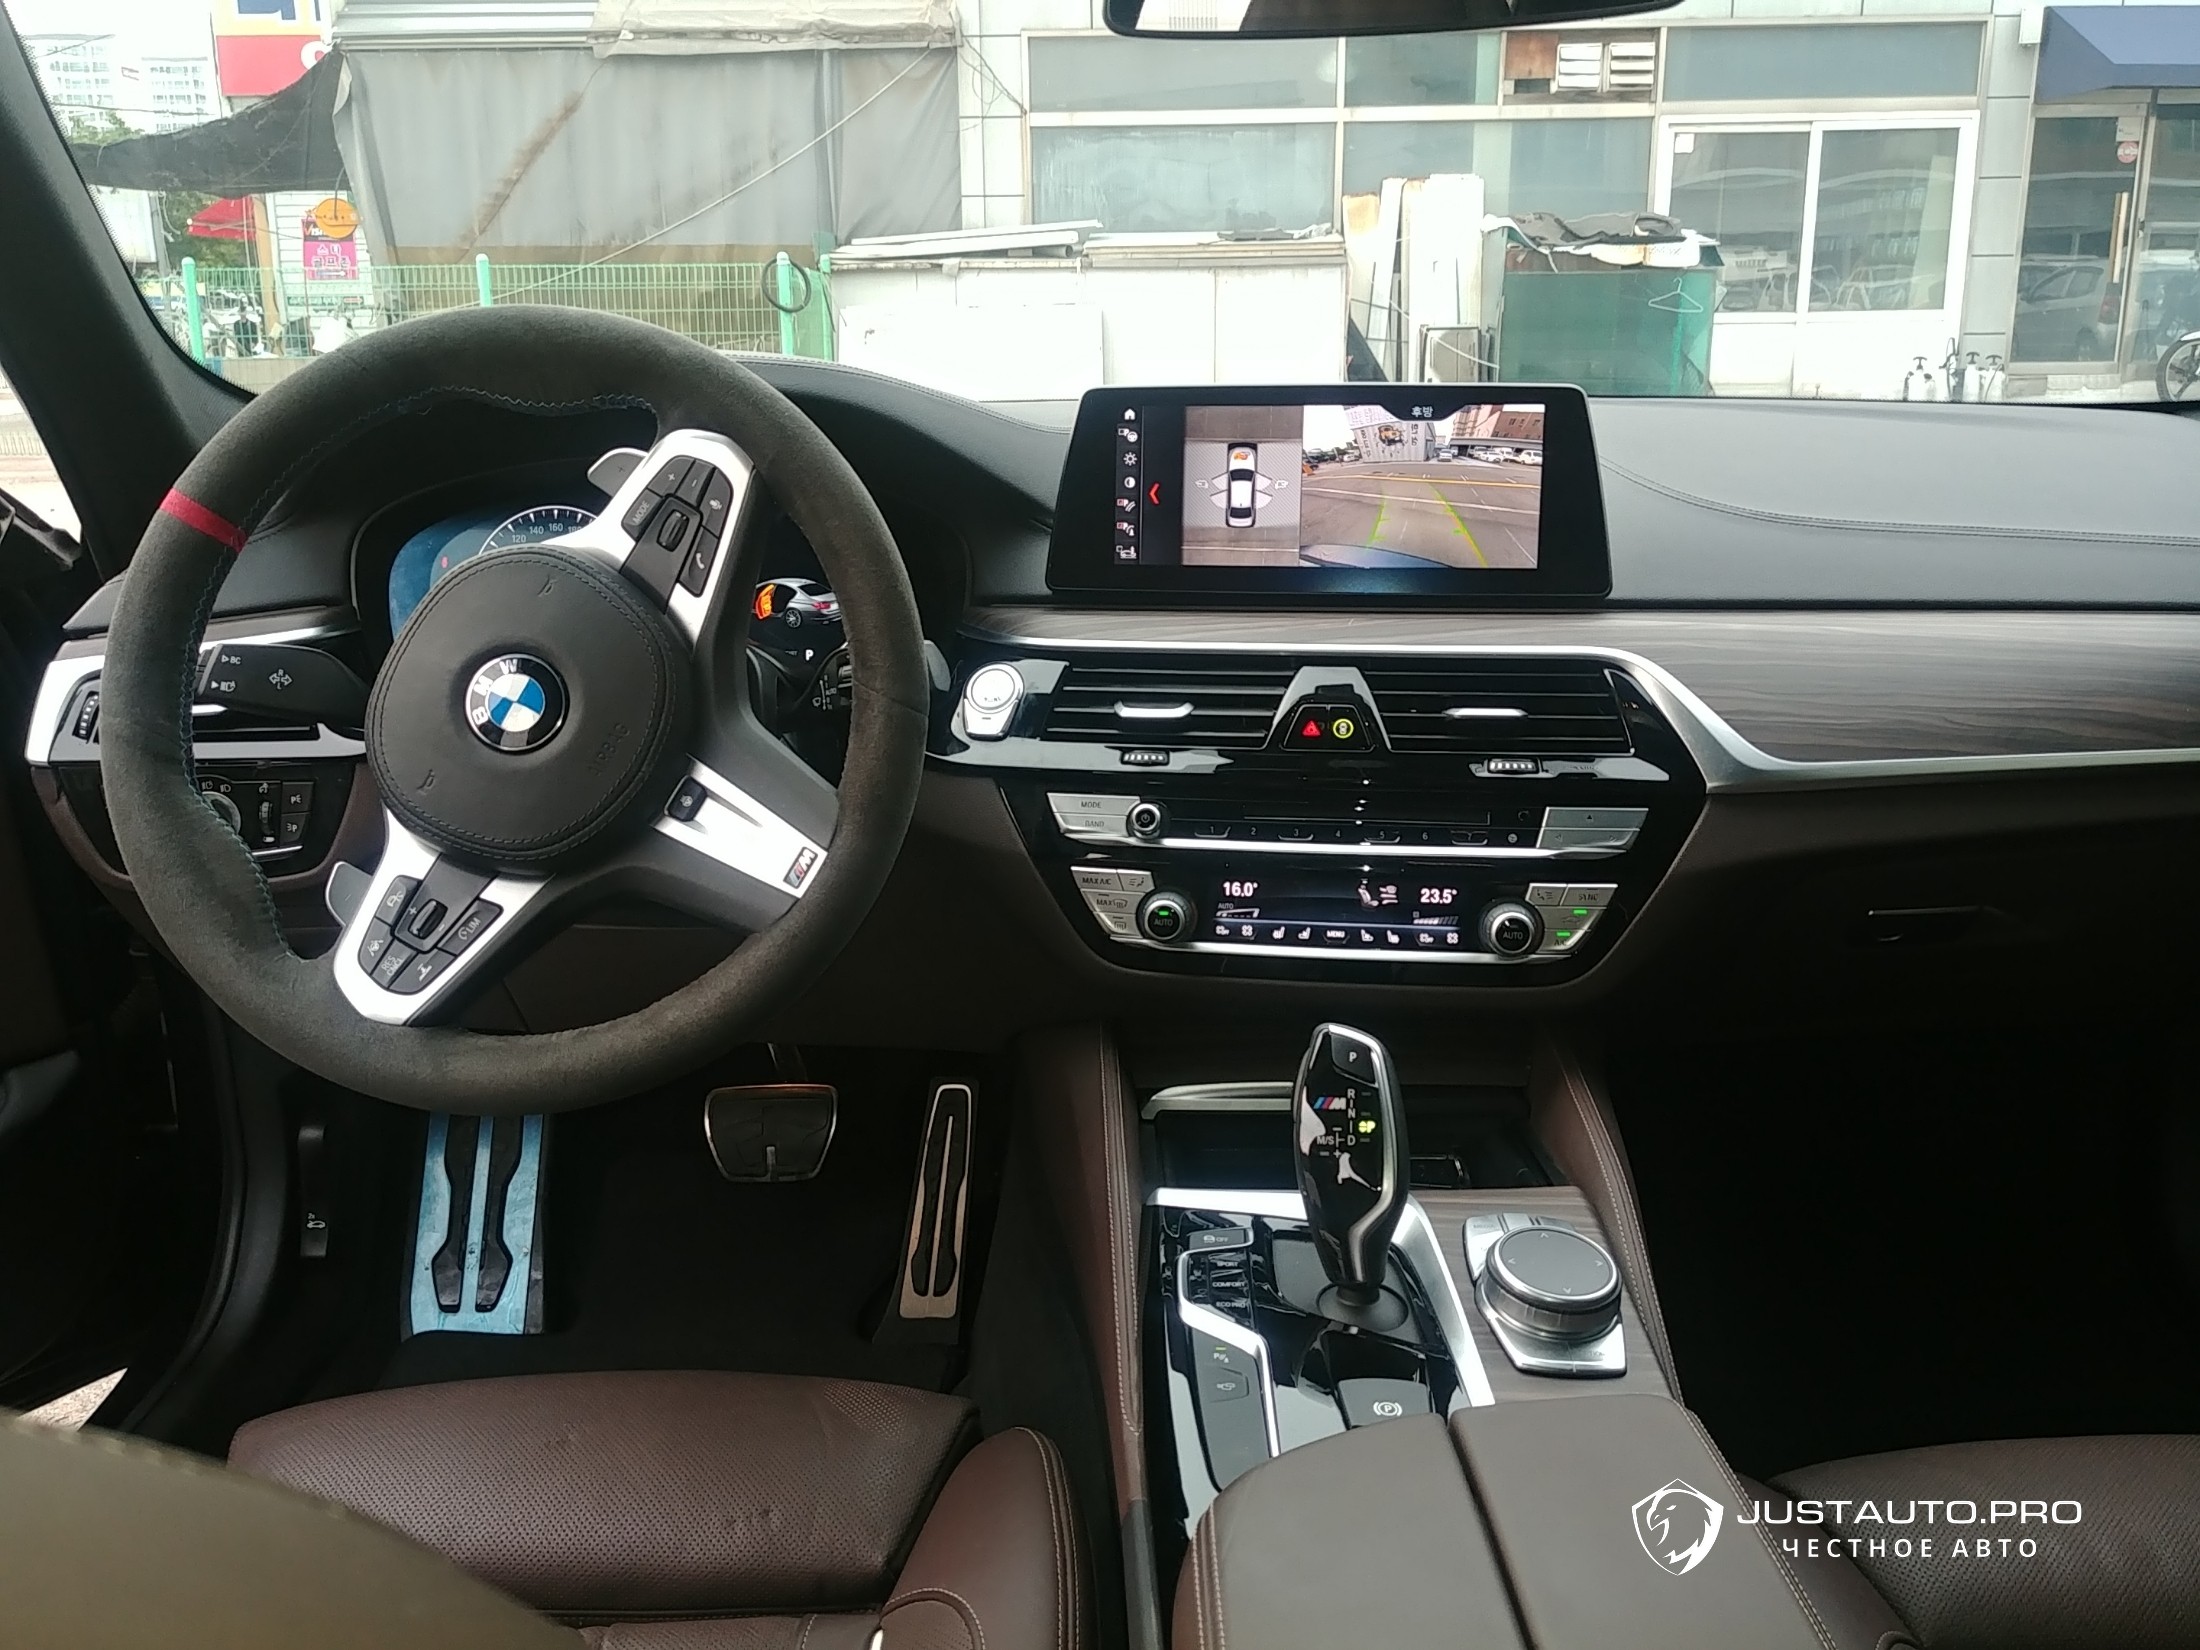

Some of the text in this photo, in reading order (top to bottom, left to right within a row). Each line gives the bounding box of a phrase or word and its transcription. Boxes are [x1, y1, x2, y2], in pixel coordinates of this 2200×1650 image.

[1411, 406, 1433, 418] 후방
[632, 500, 649, 527] MODE
[529, 526, 544, 535] 140
[549, 523, 563, 531] 160
[512, 534, 526, 543] 120
[805, 649, 814, 661] P
[230, 655, 241, 665] BC
[278, 669, 284, 677] R
[472, 659, 519, 725] BMW
[1209, 826, 1215, 834] 1
[1251, 827, 1256, 836] 2
[1293, 829, 1299, 837] 3
[1335, 829, 1341, 838] 4
[1379, 831, 1385, 839] 5
[1422, 832, 1428, 840] 6
[1082, 877, 1112, 885] MAX A/C
[1578, 893, 1599, 902] SYNC
[1096, 899, 1113, 907] MAX
[467, 917, 482, 935] LIM
[1154, 918, 1173, 927] AUTO
[1326, 930, 1345, 938] MENU
[1503, 931, 1523, 940] AUTO
[381, 955, 396, 970] RES
[1349, 1051, 1357, 1063] P
[1347, 1089, 1355, 1099] R
[1347, 1108, 1356, 1119] N
[1317, 1135, 1356, 1146] M/S D
